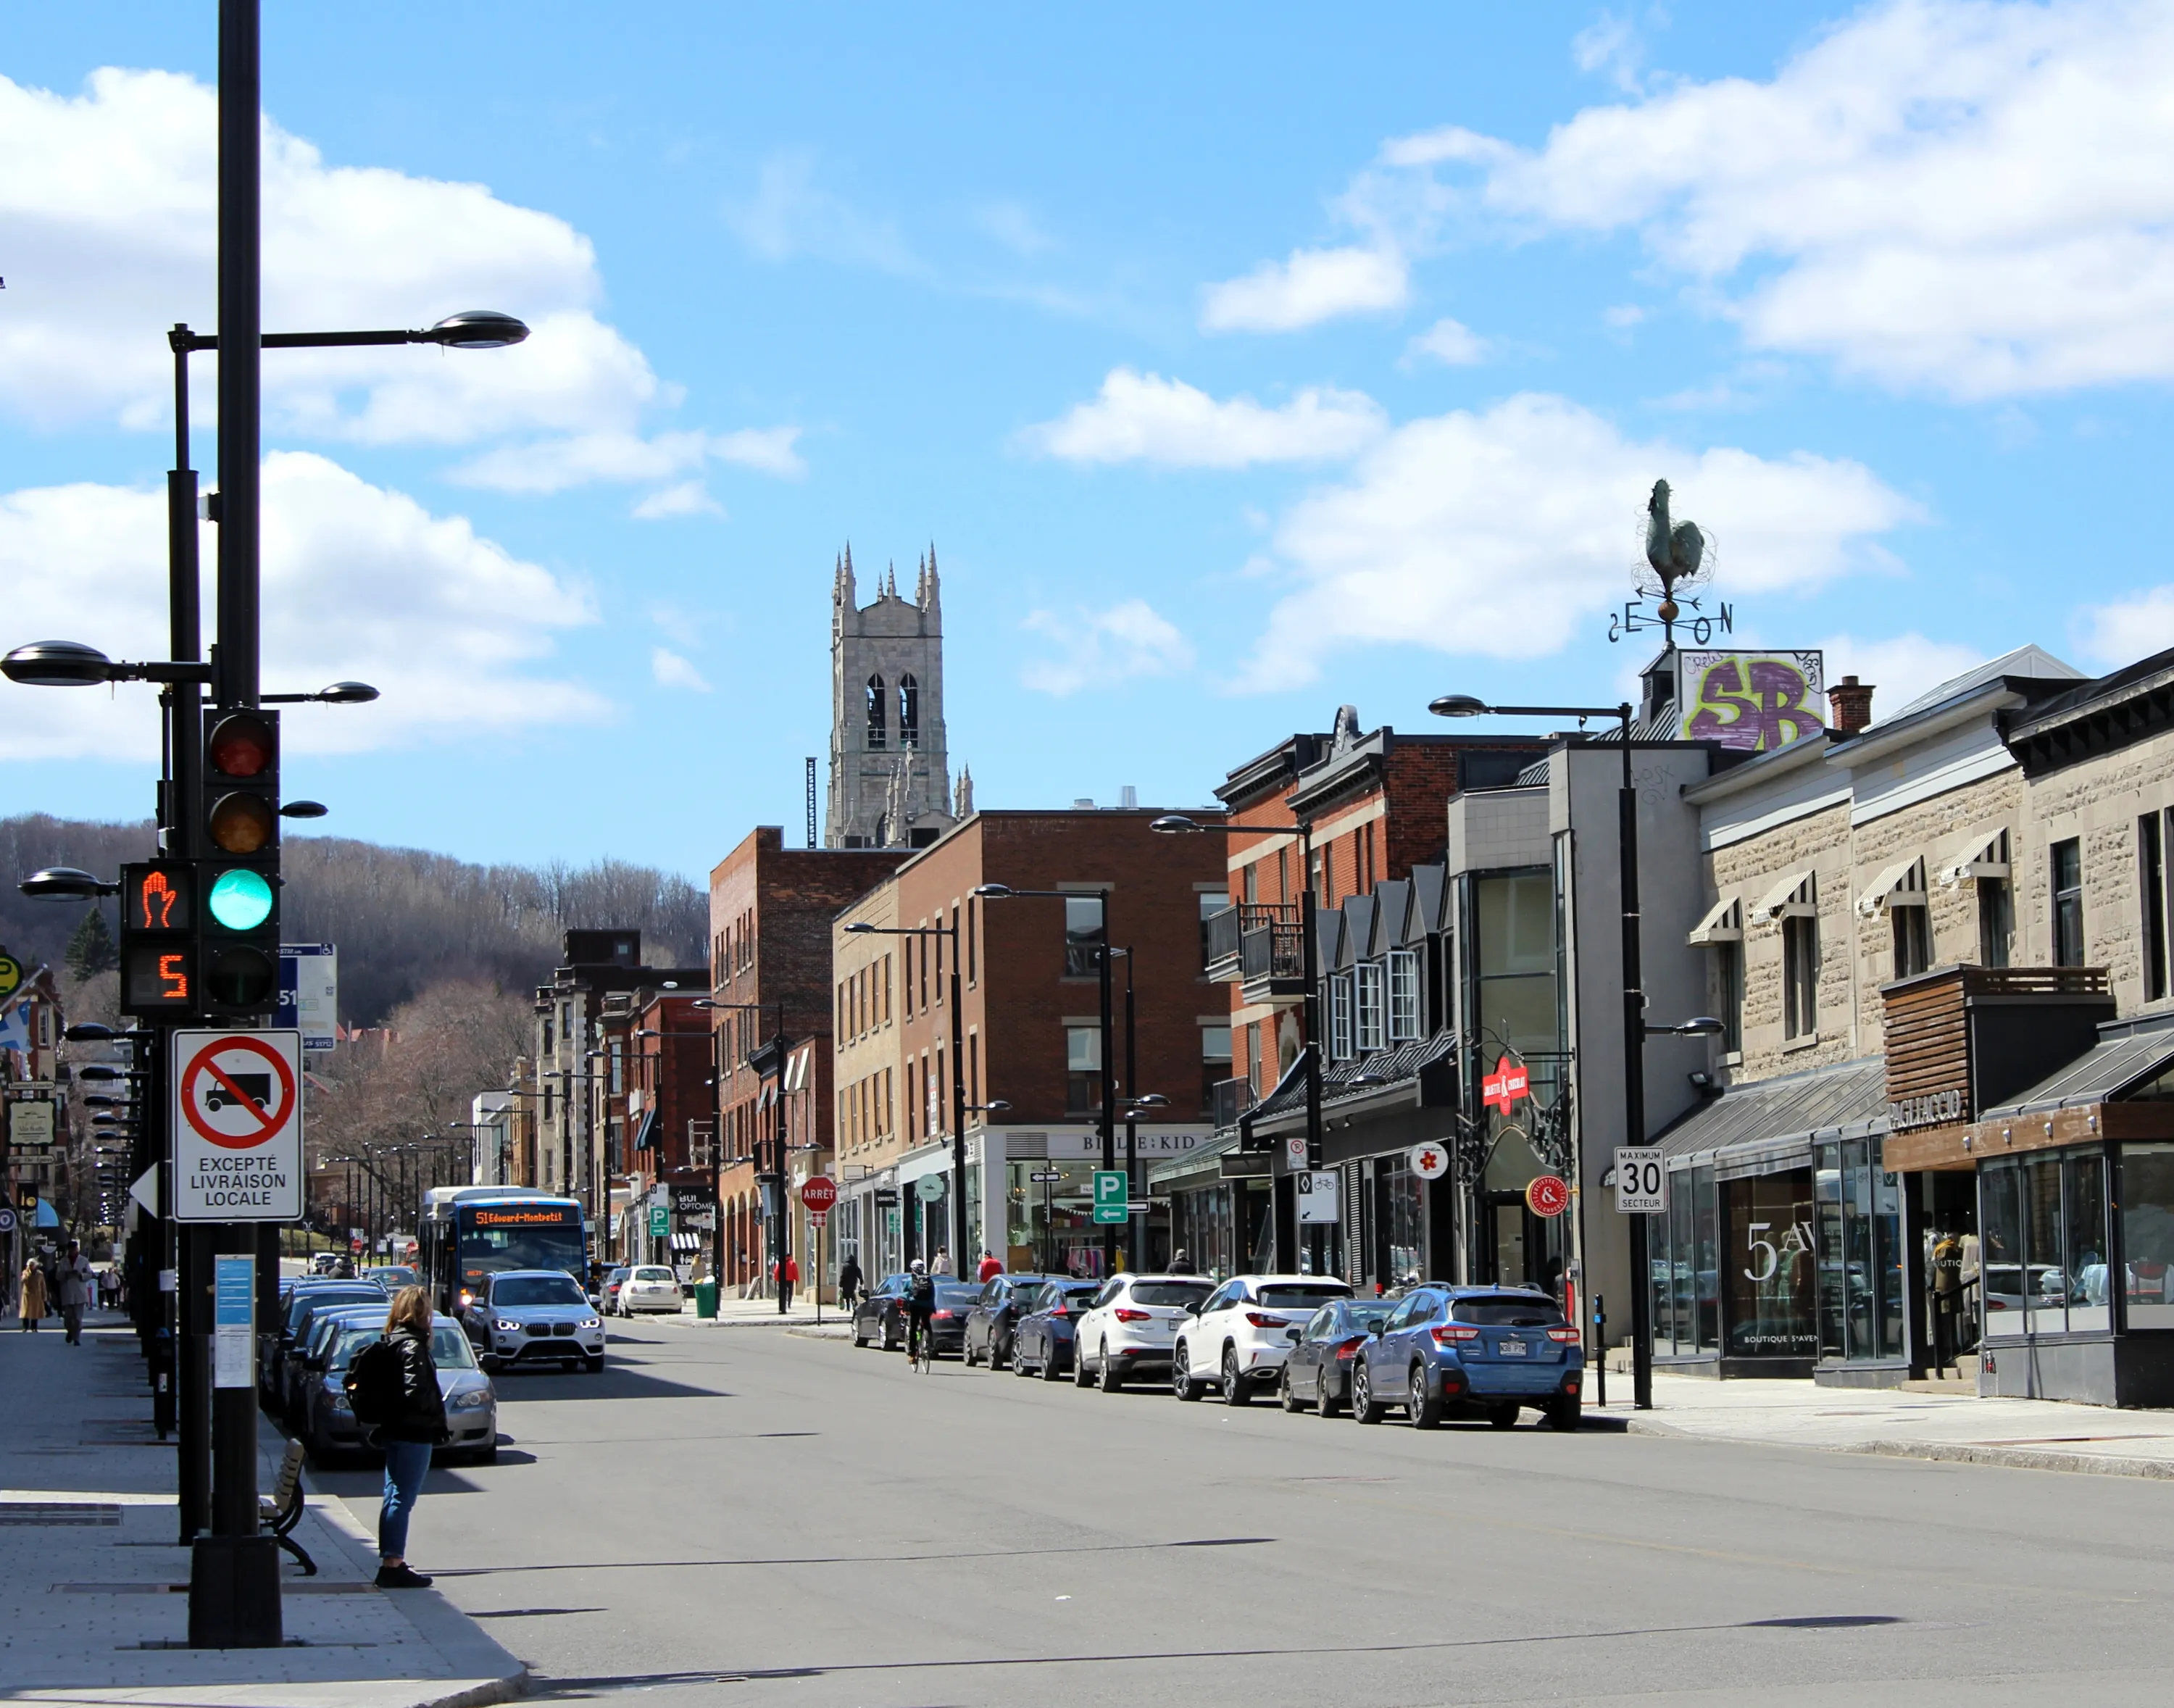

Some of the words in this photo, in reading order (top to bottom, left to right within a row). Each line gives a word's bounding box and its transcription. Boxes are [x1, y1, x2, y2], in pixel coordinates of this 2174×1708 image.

[1720, 601, 1733, 634] N
[159, 955, 187, 997] 5
[280, 990, 297, 1006] 51
[1083, 1137, 1147, 1150] BILE
[1160, 1136, 1195, 1149] KID
[199, 1154, 277, 1171] EXCEPTÉ
[191, 1174, 286, 1189] LIVRAISON
[1623, 1162, 1661, 1195] 30
[804, 1188, 835, 1199] ARRÊT
[1100, 1176, 1120, 1201] P
[206, 1191, 272, 1206] LOCALE
[680, 1201, 713, 1210] OPTOMÉ
[1623, 1199, 1660, 1208] SECTEUR
[475, 1212, 488, 1225] 51
[1744, 1222, 1778, 1281] 5
[1783, 1221, 1815, 1252] AV
[1744, 1335, 1788, 1344] BOUTIQUE
